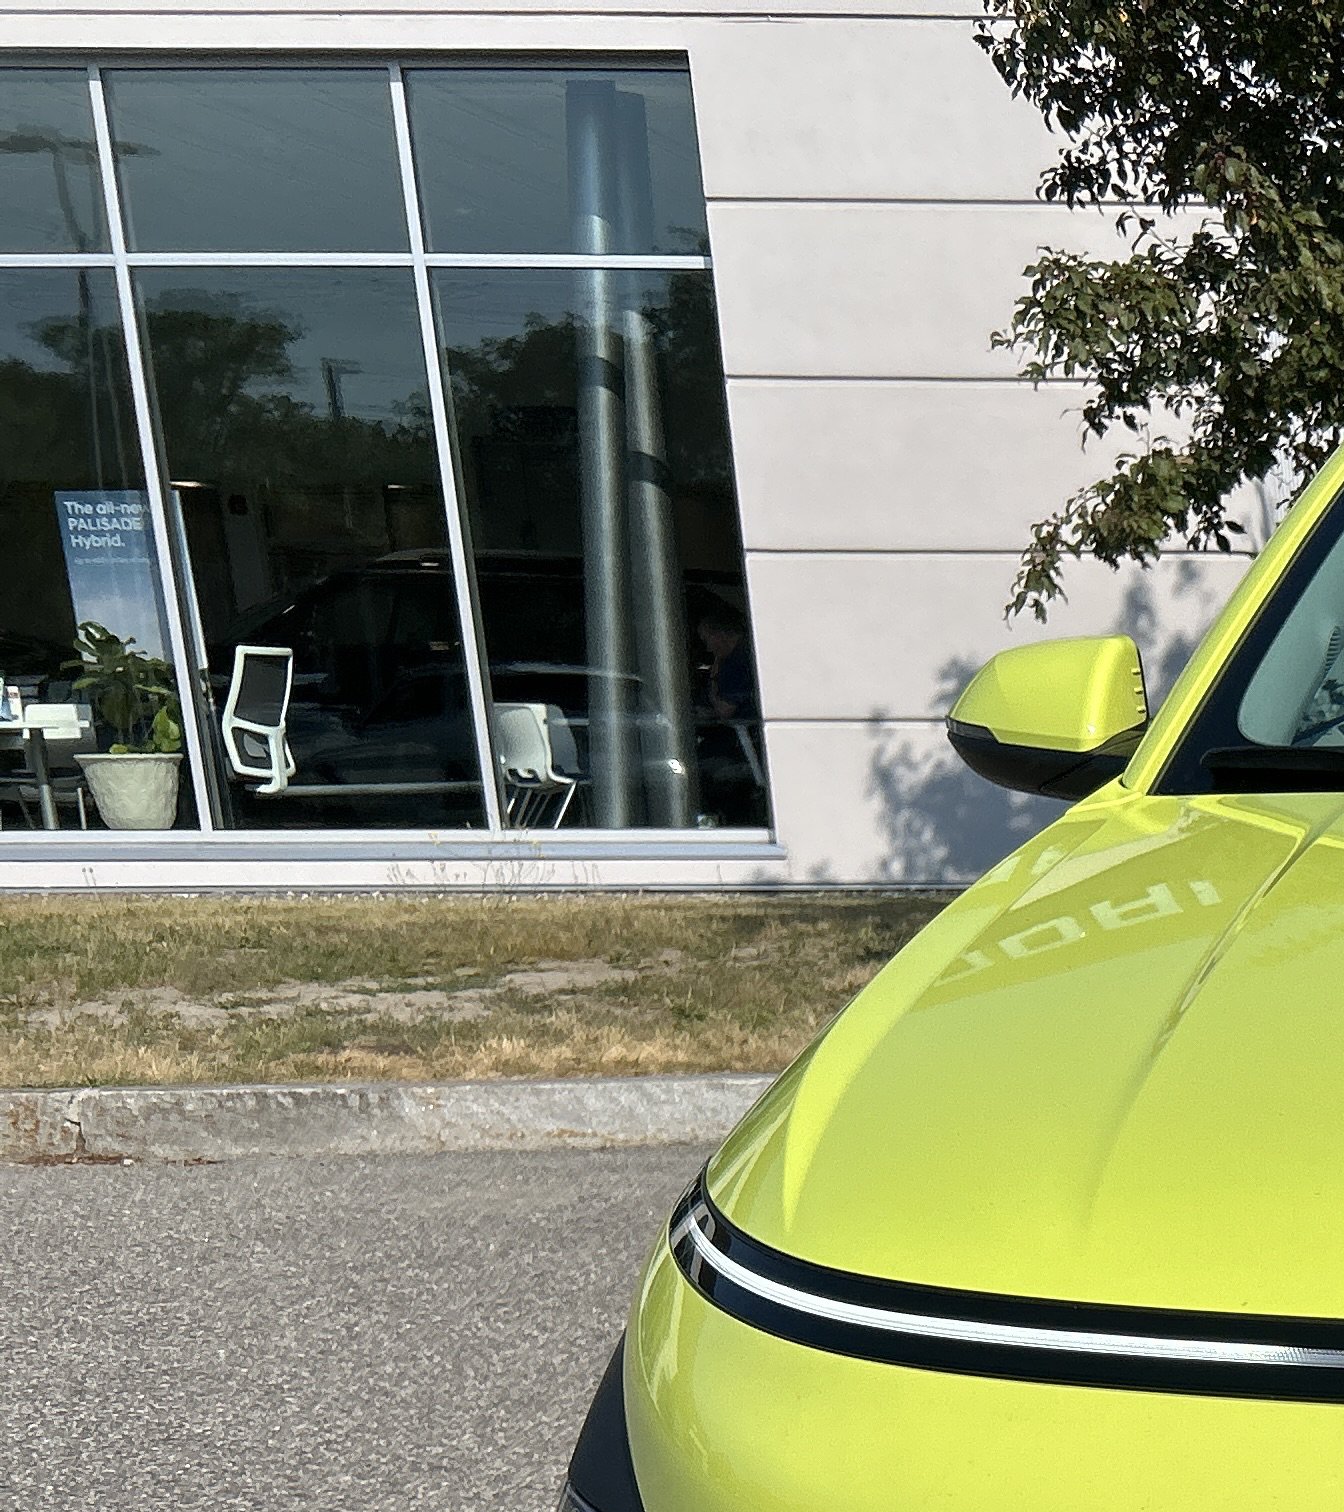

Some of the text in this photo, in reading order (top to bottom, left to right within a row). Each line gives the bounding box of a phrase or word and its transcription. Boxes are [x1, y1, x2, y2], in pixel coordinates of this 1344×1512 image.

[64, 501, 93, 515] The
[67, 517, 144, 531] PALISADE
[70, 533, 126, 549] Hybrid.
